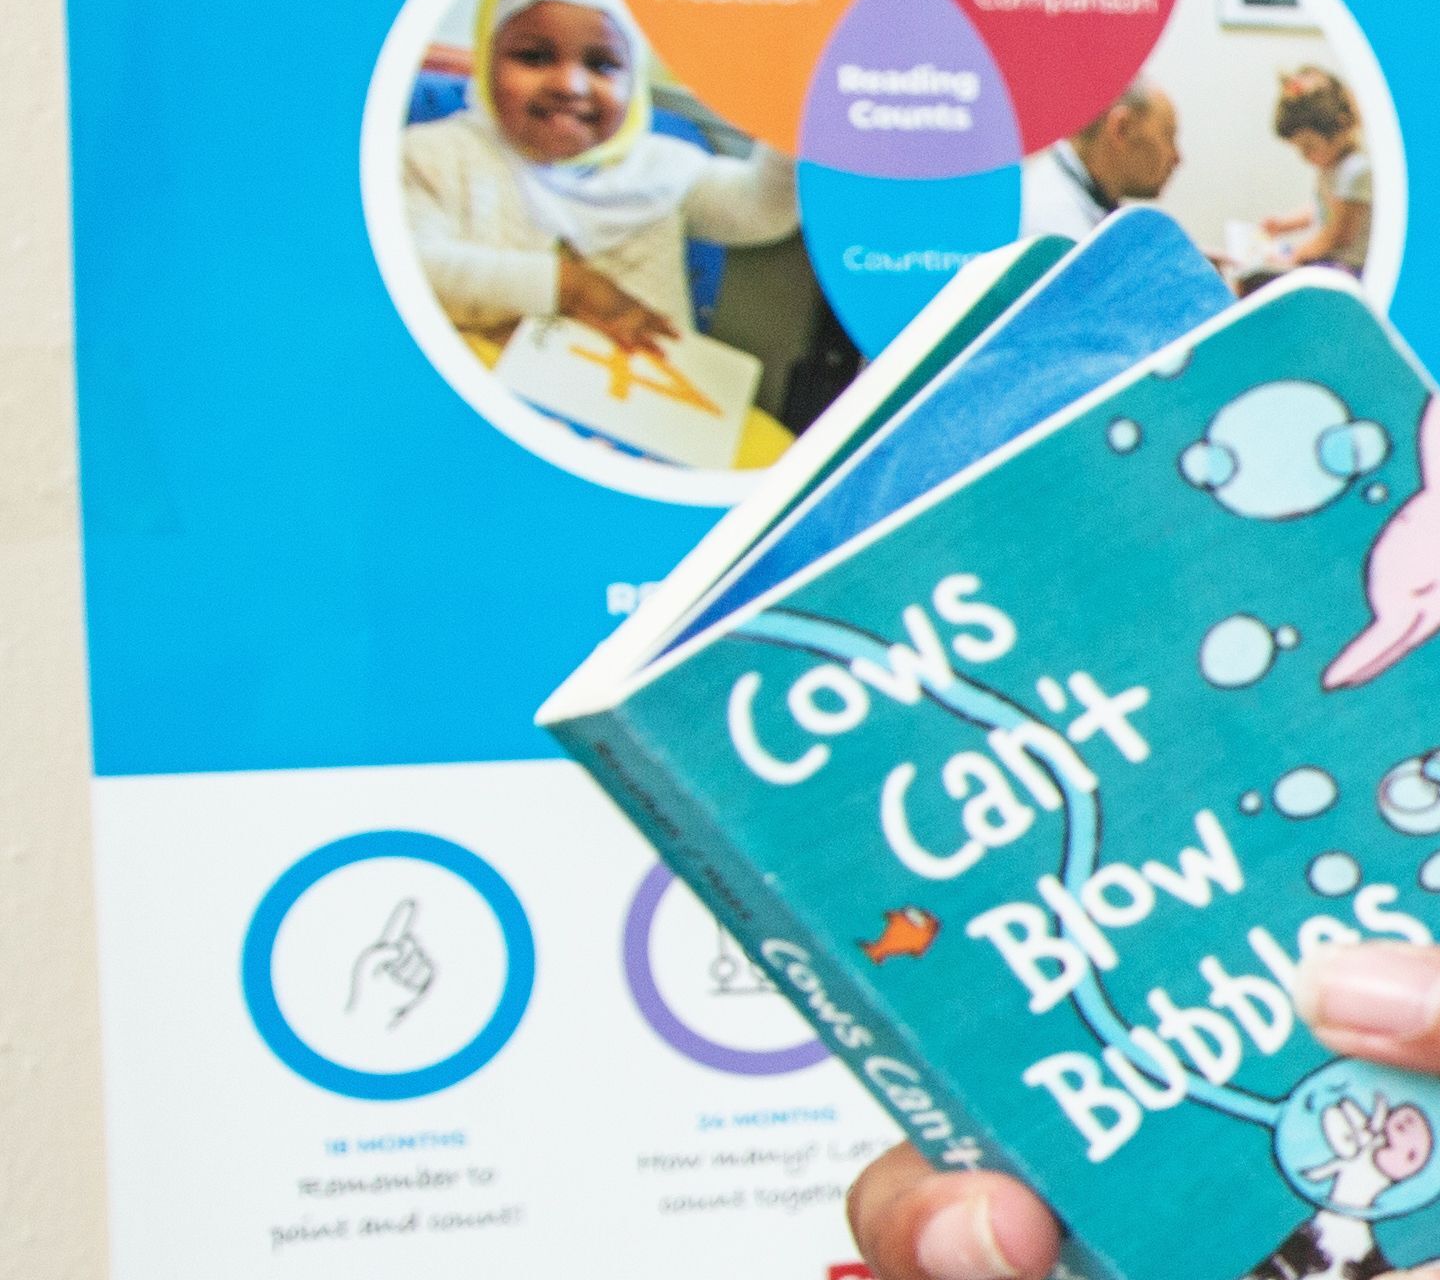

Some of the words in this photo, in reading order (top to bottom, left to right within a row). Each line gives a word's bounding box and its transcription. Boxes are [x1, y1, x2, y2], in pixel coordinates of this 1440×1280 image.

[836, 64, 981, 101] Reading
[848, 100, 972, 132] Counts
[725, 573, 1017, 785] Cows
[880, 670, 1151, 879] Can't
[965, 810, 1246, 1014] Blow
[760, 937, 874, 1050] Cows
[354, 1128, 467, 1153] MONTHS
[297, 1168, 459, 1198] Remember
[465, 1165, 499, 1187] to
[355, 1206, 417, 1236] and
